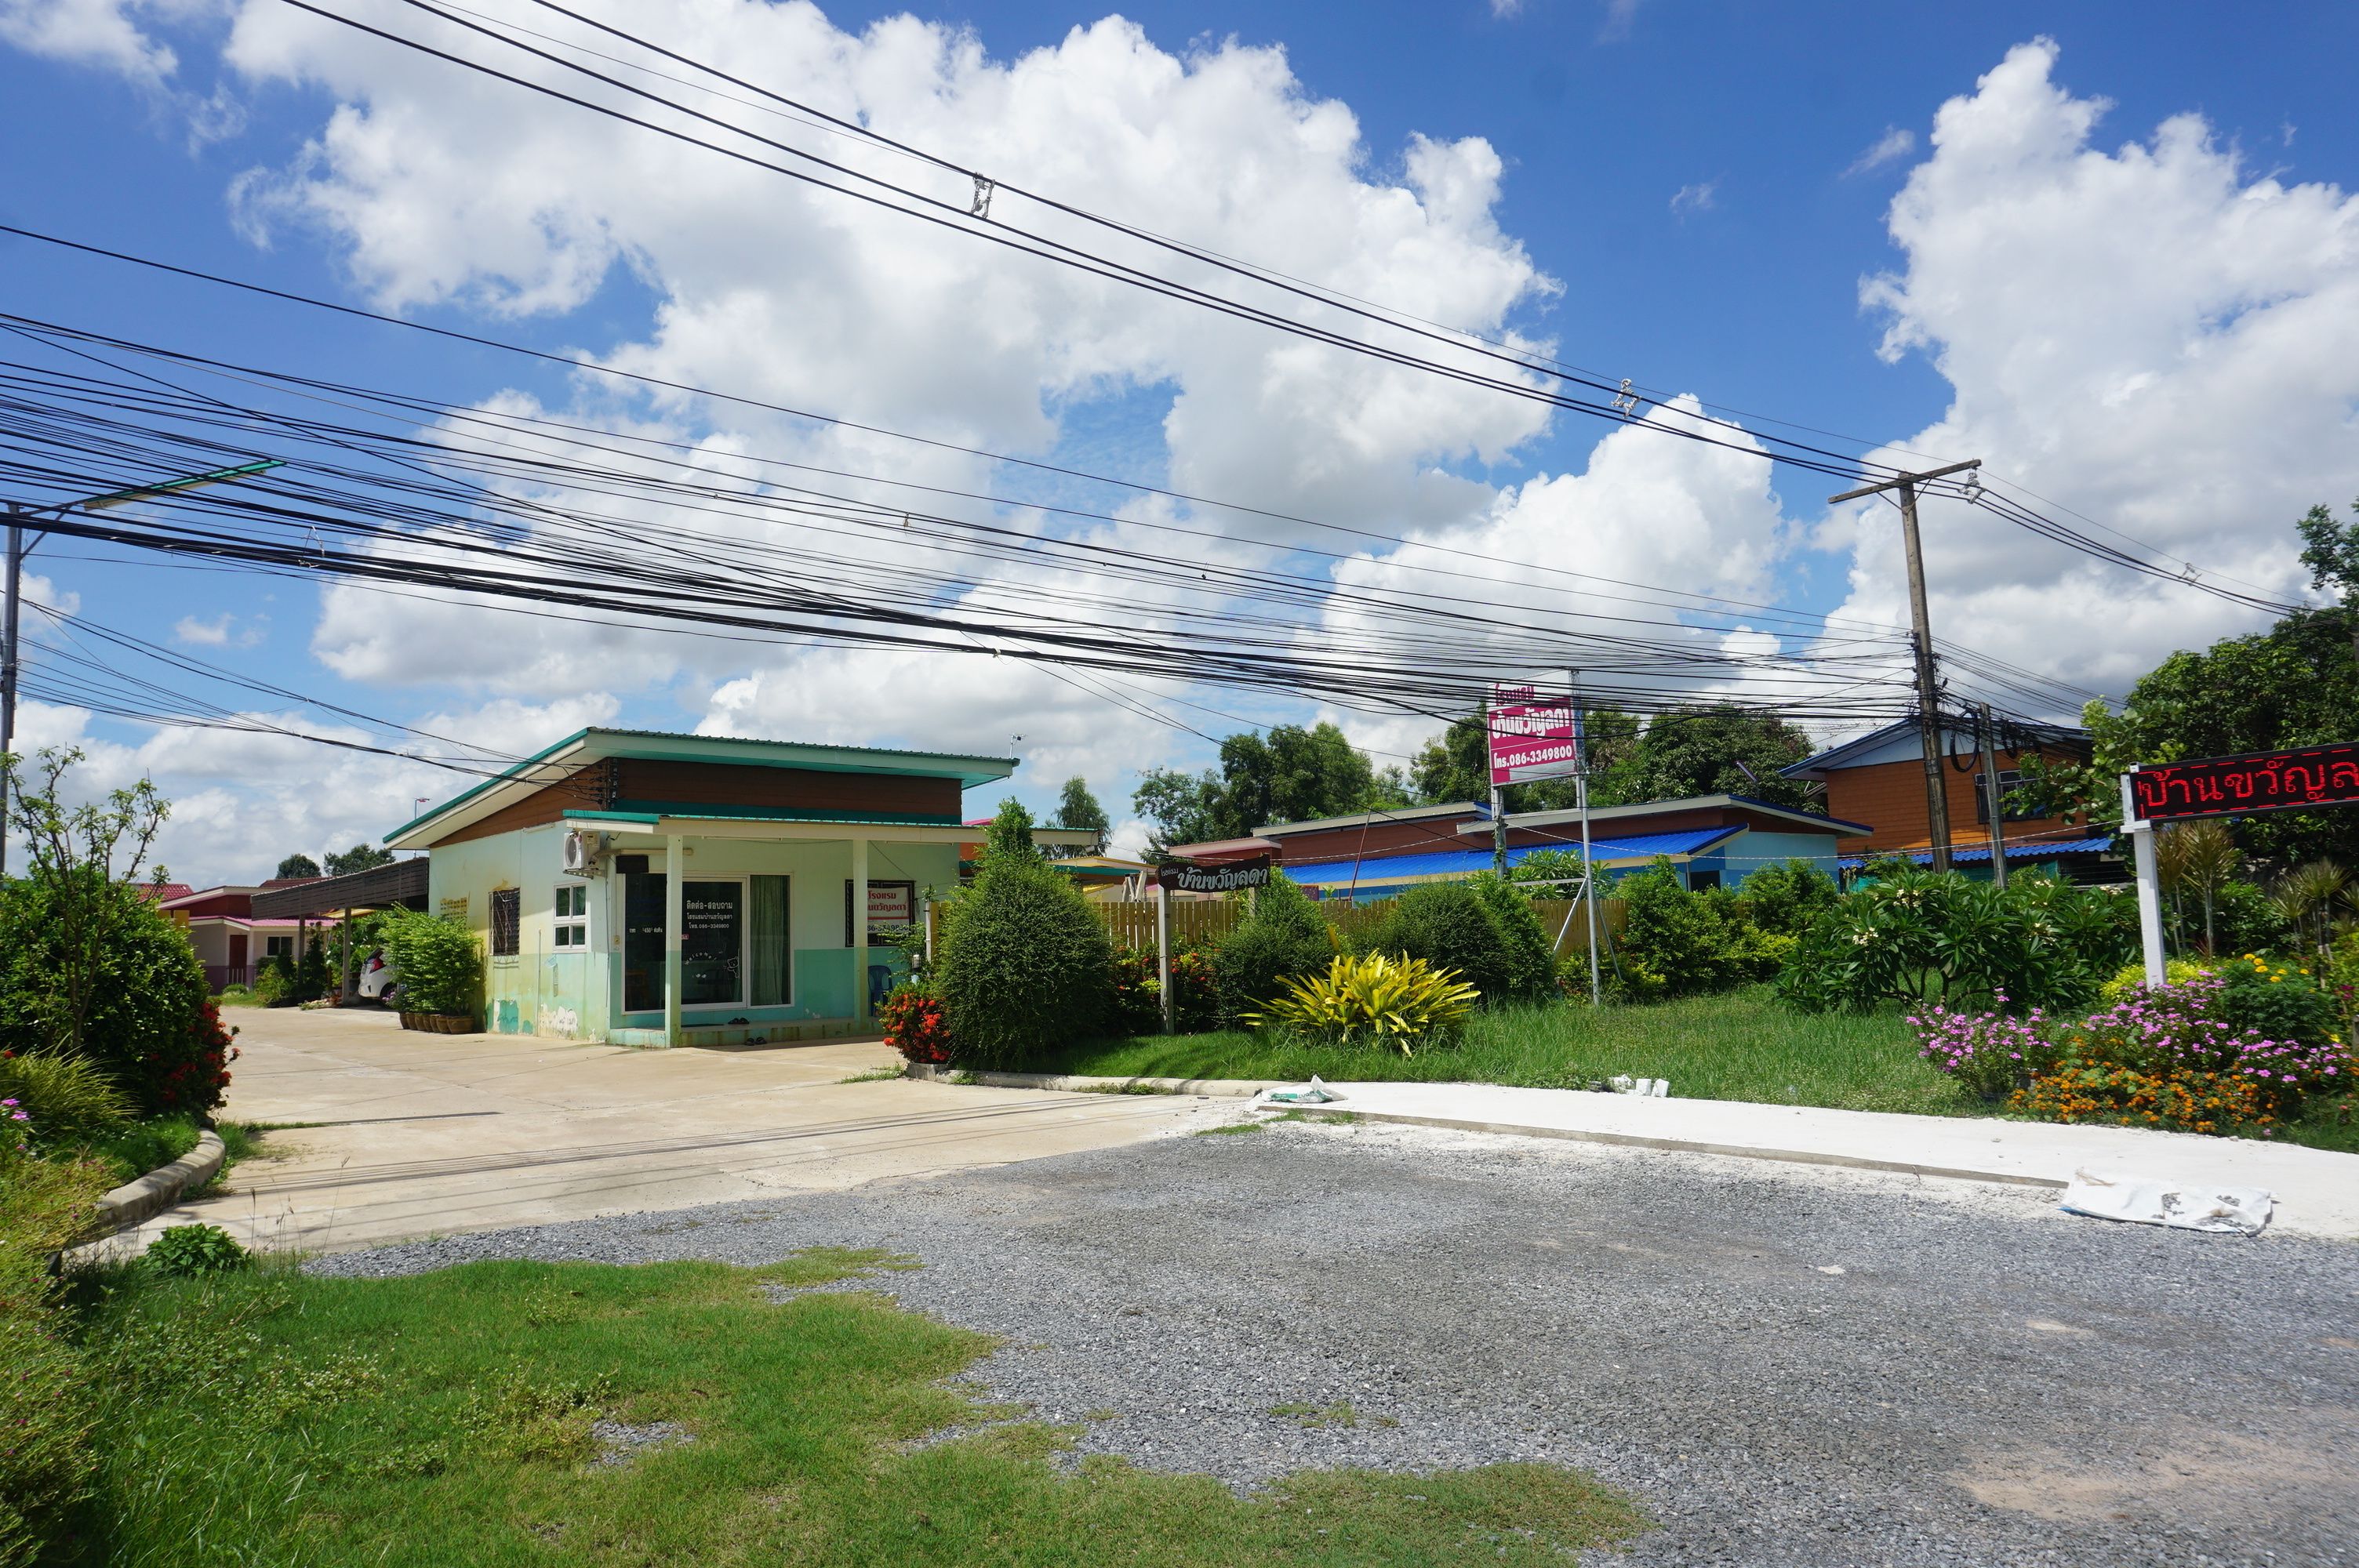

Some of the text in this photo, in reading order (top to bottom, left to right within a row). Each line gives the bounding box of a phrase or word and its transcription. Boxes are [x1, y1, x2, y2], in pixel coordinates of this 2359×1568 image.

[1492, 707, 1569, 740] บ้านขวัญลดา
[1493, 745, 1572, 769] โทร.086-3349800
[2142, 760, 2359, 807] บ้านขวัญล
[1177, 866, 1268, 891] บ้านขวัญลดา
[686, 899, 733, 909] ติดต่อ-สอบถาม
[868, 891, 896, 899] โรงแรม
